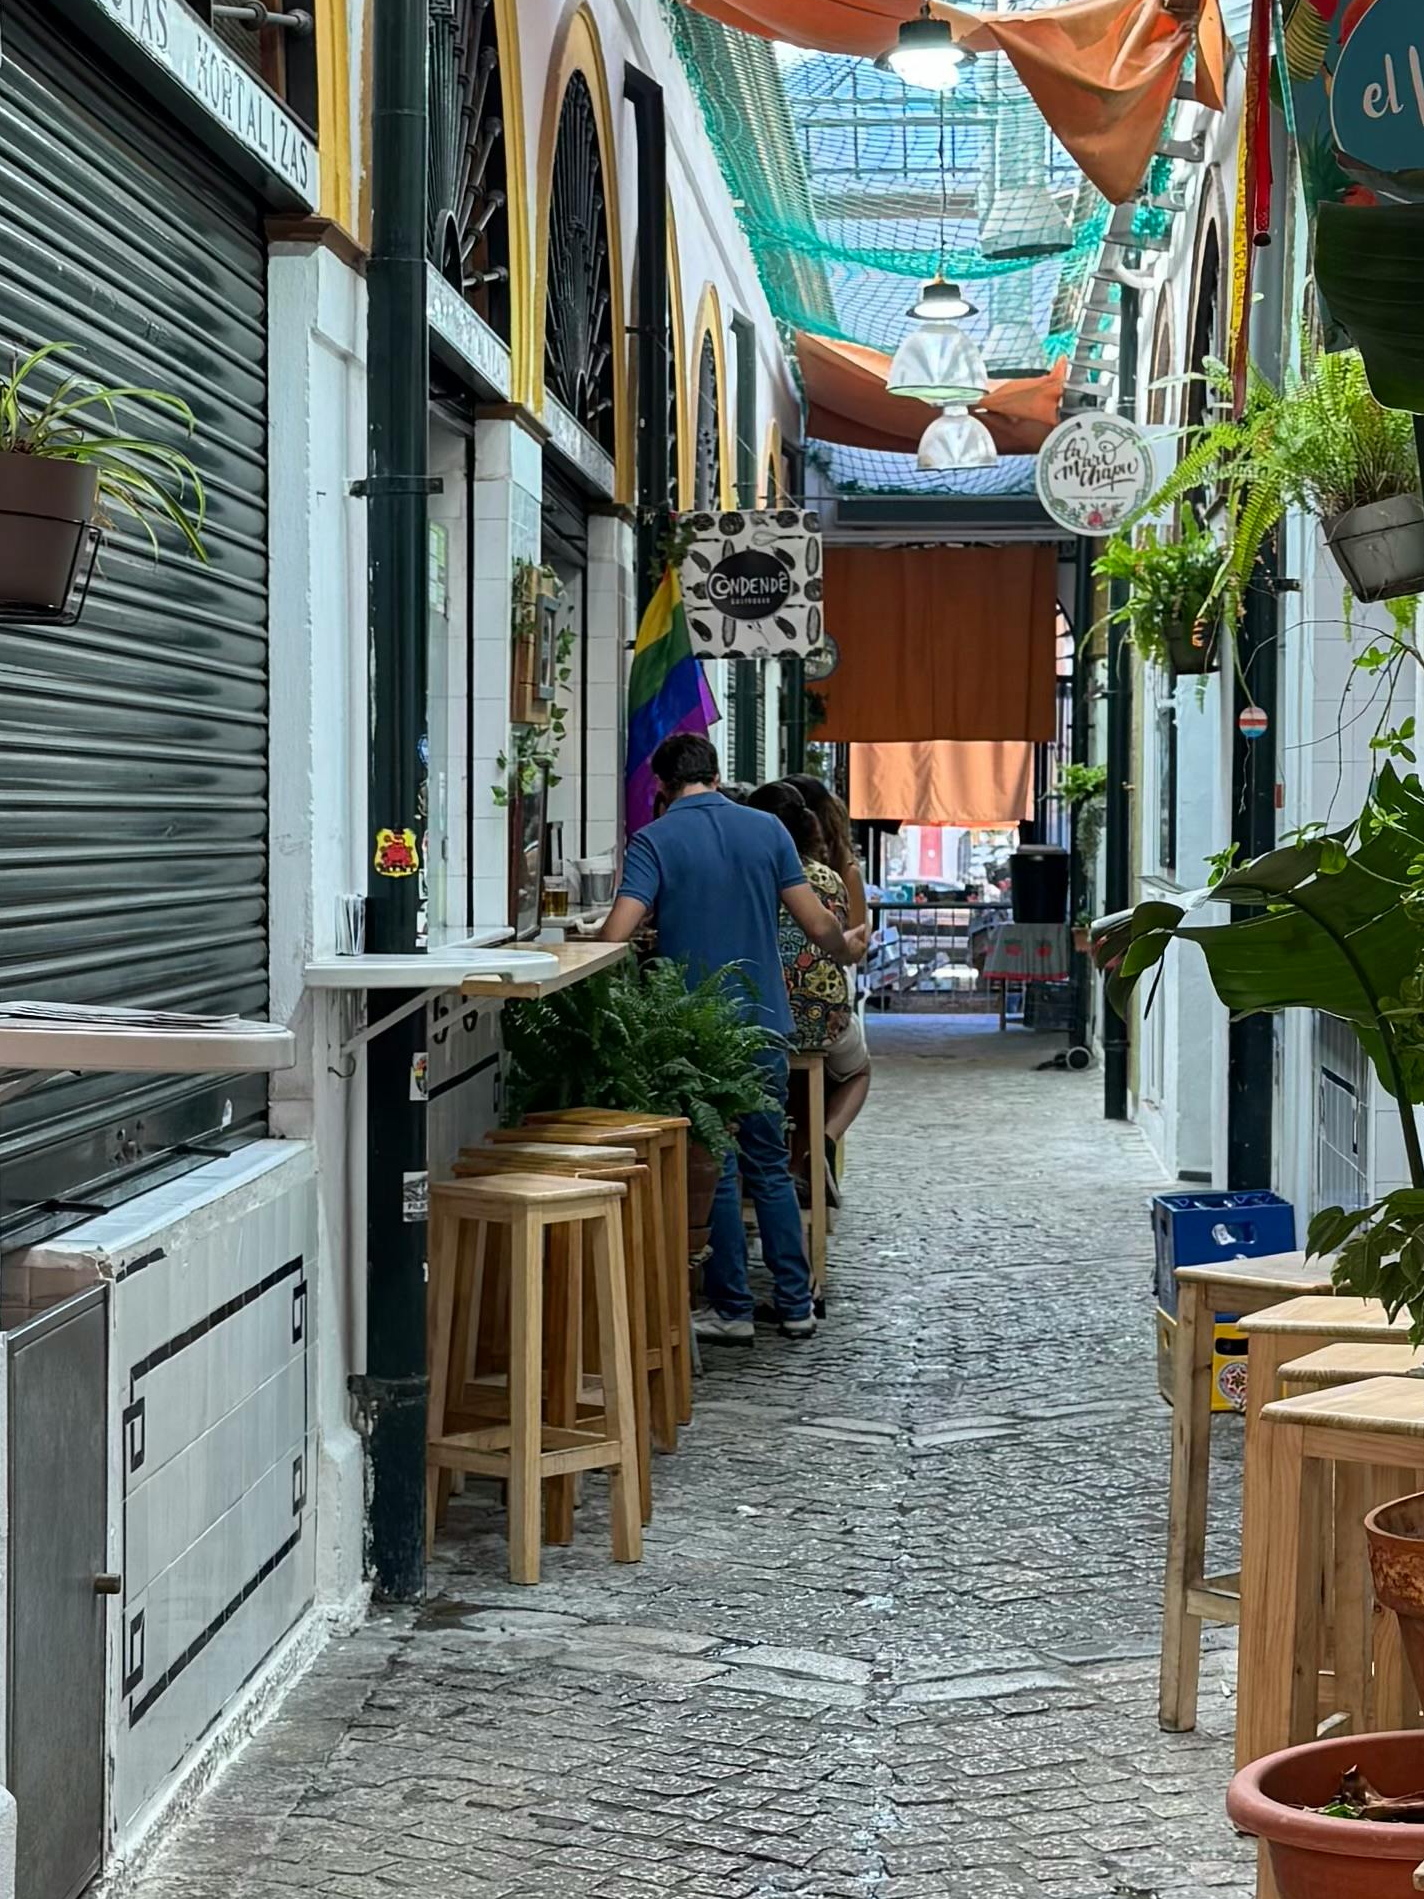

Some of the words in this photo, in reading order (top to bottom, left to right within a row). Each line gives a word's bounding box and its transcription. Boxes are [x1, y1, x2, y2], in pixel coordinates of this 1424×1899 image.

[196, 32, 309, 191] HORTALIZAS
[1363, 53, 1404, 118] el
[708, 571, 789, 600] CONDENDÊ
